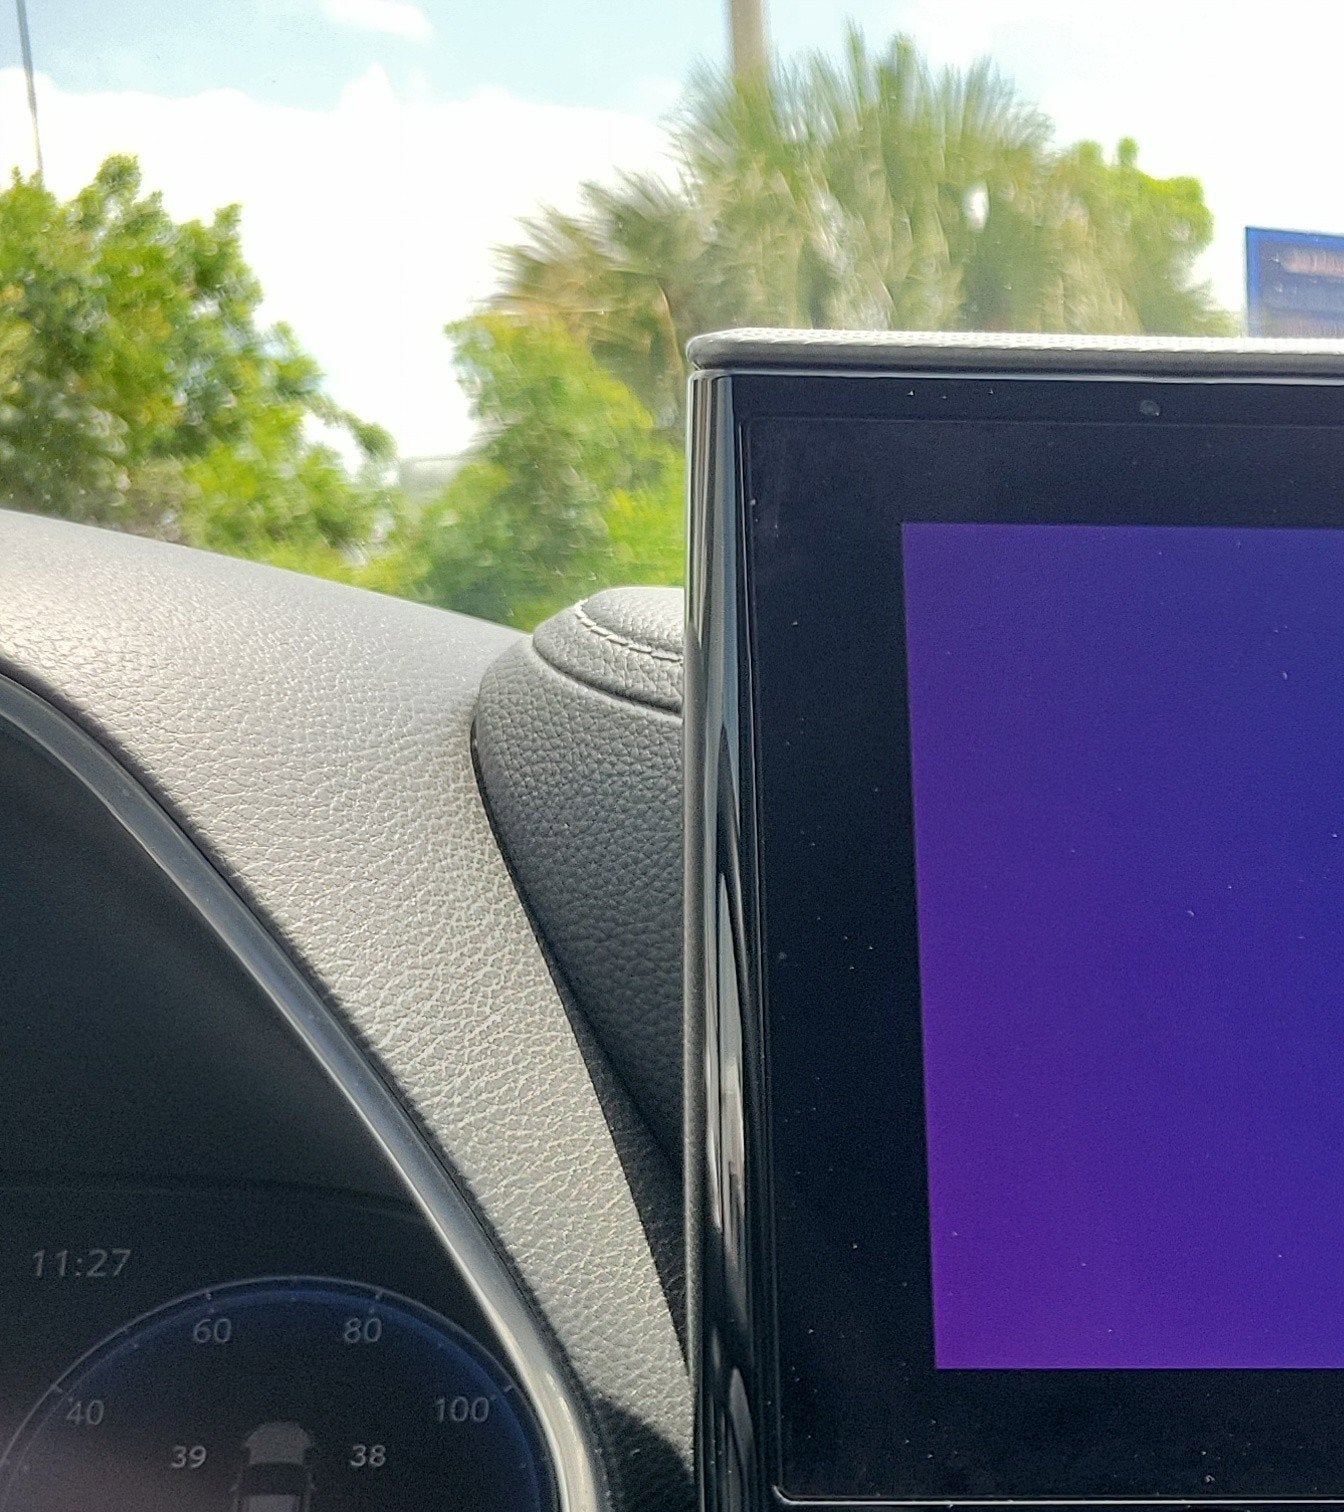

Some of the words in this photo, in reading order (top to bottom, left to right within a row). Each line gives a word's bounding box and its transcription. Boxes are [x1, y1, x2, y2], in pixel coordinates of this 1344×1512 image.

[33, 1249, 131, 1278] 11:27
[192, 1318, 232, 1344] 60
[343, 1317, 382, 1343] 80
[66, 1399, 105, 1426] 40
[434, 1397, 489, 1423] 100
[171, 1444, 207, 1469] 39
[350, 1444, 386, 1467] 38
